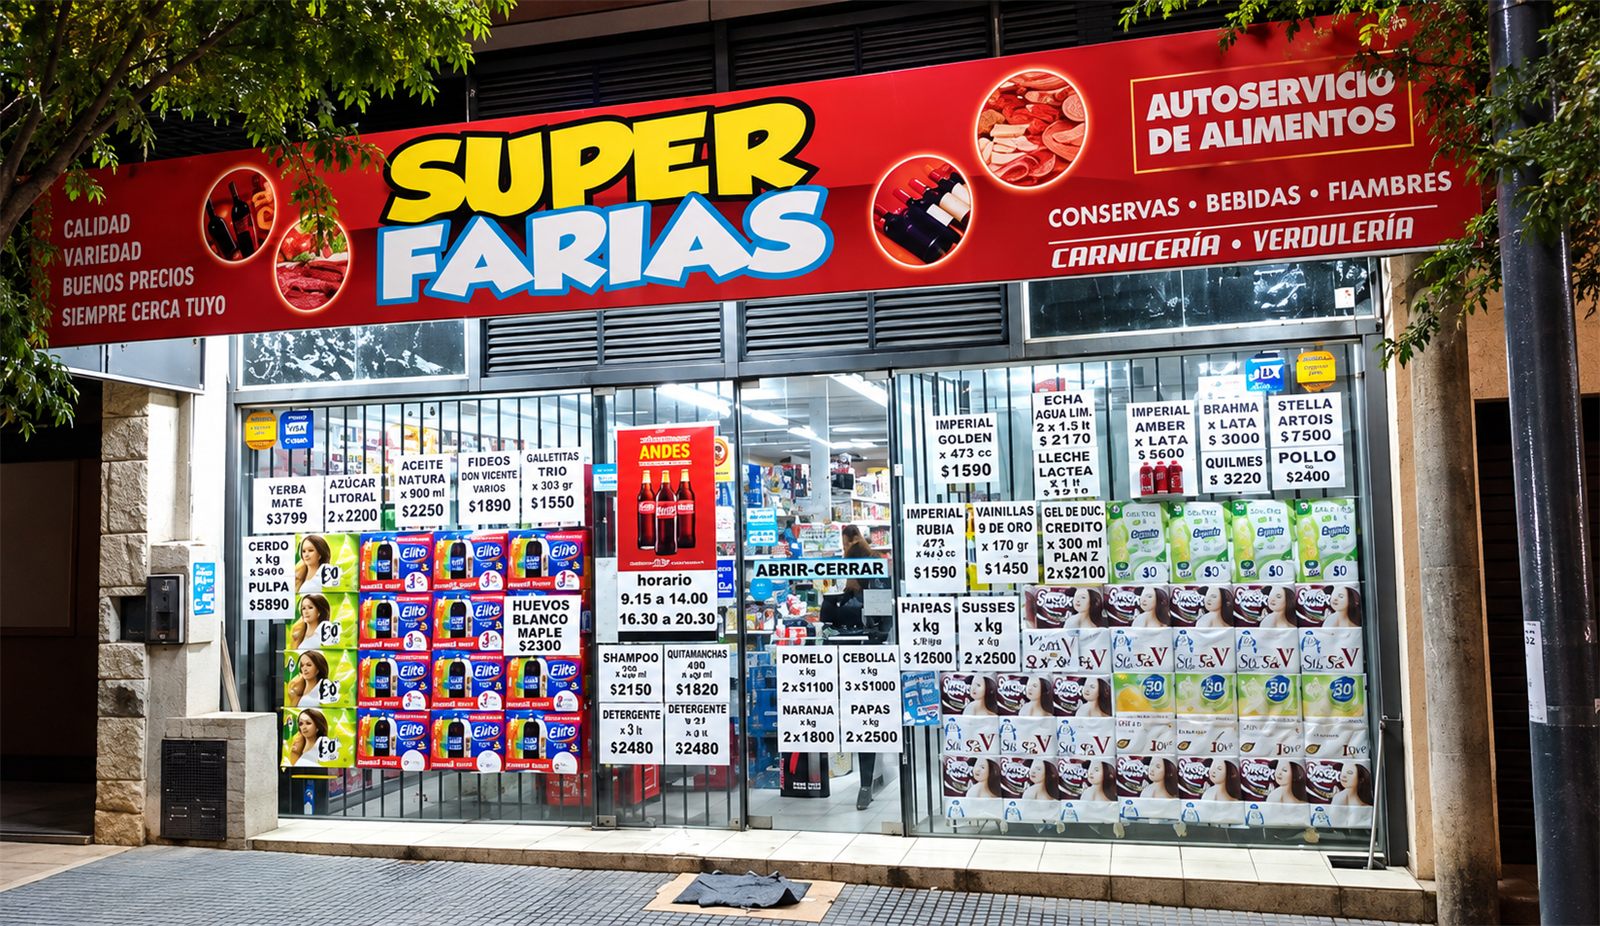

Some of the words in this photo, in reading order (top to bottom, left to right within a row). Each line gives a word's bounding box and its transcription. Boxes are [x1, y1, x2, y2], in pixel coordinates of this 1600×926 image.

[1146, 69, 1395, 121] AUTOSERVICIO
[1149, 125, 1191, 155] DE
[1200, 104, 1395, 150] ALIMENTOS
[382, 100, 814, 224] SUPER
[1049, 197, 1180, 228] CONSERVAS
[1207, 186, 1300, 212] BEBIDAS
[1329, 170, 1452, 201] FIAMBRES
[64, 214, 130, 239] CALIDAD
[380, 187, 830, 303] FARIAS
[1051, 231, 1220, 269] CARNICERÍA
[1254, 214, 1413, 252] VERDULERÍA
[64, 241, 141, 266] VARIEDAD
[63, 273, 123, 295] BUENOS
[129, 267, 194, 289] PRECIOS
[62, 304, 126, 327] SIEMPRE
[131, 300, 180, 320] CERCA
[185, 295, 226, 316] TUYO
[1044, 394, 1083, 405] ECHA
[1278, 398, 1332, 411] STELLA
[1132, 406, 1190, 417] IMPERIAL
[1204, 402, 1258, 414] BRAHMA
[1036, 410, 1066, 420] AGUA
[1070, 408, 1092, 417] LIM.
[936, 418, 993, 430] IMPERIAL
[1208, 421, 1215, 429] x
[1221, 419, 1256, 429] LATA
[1279, 414, 1333, 426] ARTOIS
[1037, 423, 1045, 432] 2
[1060, 421, 1078, 431] 1.5
[1082, 421, 1090, 430] lt
[1136, 421, 1185, 432] AMBER
[938, 433, 992, 444] GOLDEN
[1135, 438, 1142, 446] x
[1150, 435, 1188, 446] LATA
[527, 452, 579, 462] GALLETITAS
[640, 443, 690, 460] ANDES
[951, 449, 974, 458] 473
[978, 449, 992, 457] cc
[1279, 450, 1336, 463] POLLO
[468, 456, 510, 467] FIDEOS
[1039, 452, 1089, 463] LLECHE
[1206, 456, 1262, 469] QUILMES
[402, 460, 443, 471] ACEITE
[941, 463, 991, 478] $1590
[462, 472, 480, 481] DON
[482, 470, 517, 480] VICENTE
[538, 467, 567, 476] TRIO
[1039, 466, 1092, 477] LACTEA
[1287, 471, 1330, 482] $2400
[330, 477, 375, 488] AZÚCAR
[399, 474, 445, 485] NATURA
[269, 485, 306, 495] YERBA
[473, 485, 505, 493] VARIOS
[541, 481, 559, 490] 303
[562, 482, 573, 491] gr
[329, 494, 376, 503] LITORAL
[410, 489, 429, 498] 900
[433, 488, 444, 497] ml
[272, 499, 303, 508] MATE
[469, 499, 511, 513] $1890
[531, 496, 574, 509] $1550
[402, 504, 443, 517] $2250
[907, 508, 963, 519] IMPERIAL
[976, 506, 1034, 517] VAINILLAS
[1045, 508, 1063, 517] GEL
[1066, 507, 1078, 516] DE
[1081, 506, 1104, 516] DUC.
[267, 512, 307, 525] $3799
[917, 524, 954, 535] RUBIA
[979, 523, 986, 533] 9
[990, 523, 1004, 533] DE
[1007, 522, 1032, 532] ORO
[1046, 522, 1103, 533] CREDITO
[249, 541, 289, 551] CERDO
[982, 543, 988, 551] x
[993, 540, 1013, 550] 170
[1017, 541, 1028, 552] gr
[1047, 541, 1055, 549] x
[1059, 538, 1082, 549] 300
[1087, 537, 1101, 548] ml
[266, 554, 280, 565] kg
[1054, 553, 1088, 562] PLAN
[756, 563, 884, 577] ABRIR-CERRAR
[914, 566, 956, 579] $1590
[985, 562, 1028, 575] $1450
[637, 574, 692, 586] horario
[250, 582, 289, 592] PULPA
[621, 593, 651, 605] 9.15
[656, 595, 664, 605] a
[669, 592, 708, 604] 14.00
[250, 599, 289, 611] $5890
[475, 603, 500, 615] Elite
[513, 600, 569, 611] HUEVOS
[962, 602, 1015, 613] SUSSES
[513, 614, 568, 625] BLANCO
[619, 613, 657, 625] 16.30
[663, 615, 671, 625] a
[676, 613, 715, 625] 20.30
[913, 623, 920, 632] x
[923, 617, 939, 634] kg
[975, 622, 982, 632] x
[986, 617, 1002, 634] kg
[518, 628, 562, 638] MAPLE
[519, 640, 561, 652] $2300
[603, 653, 658, 662] SHAMPOO
[668, 650, 727, 658] QUITAMANCHAS
[782, 654, 833, 663] POMELO
[843, 653, 896, 663] CEBOLLA
[401, 665, 424, 676] Elite
[475, 665, 499, 676] Elite
[551, 664, 576, 676] Elite
[806, 668, 815, 677] kg
[868, 667, 877, 676] kg
[610, 684, 651, 696] $2150
[676, 684, 718, 696] $1820
[603, 710, 660, 719] DETERGENTE
[669, 705, 726, 714] DETERGENTE
[783, 705, 834, 715] NARANJA
[851, 705, 890, 714] PAPAS
[807, 719, 816, 727] kg
[869, 719, 879, 727] kg
[628, 724, 633, 735] 3
[611, 742, 653, 754] $2480
